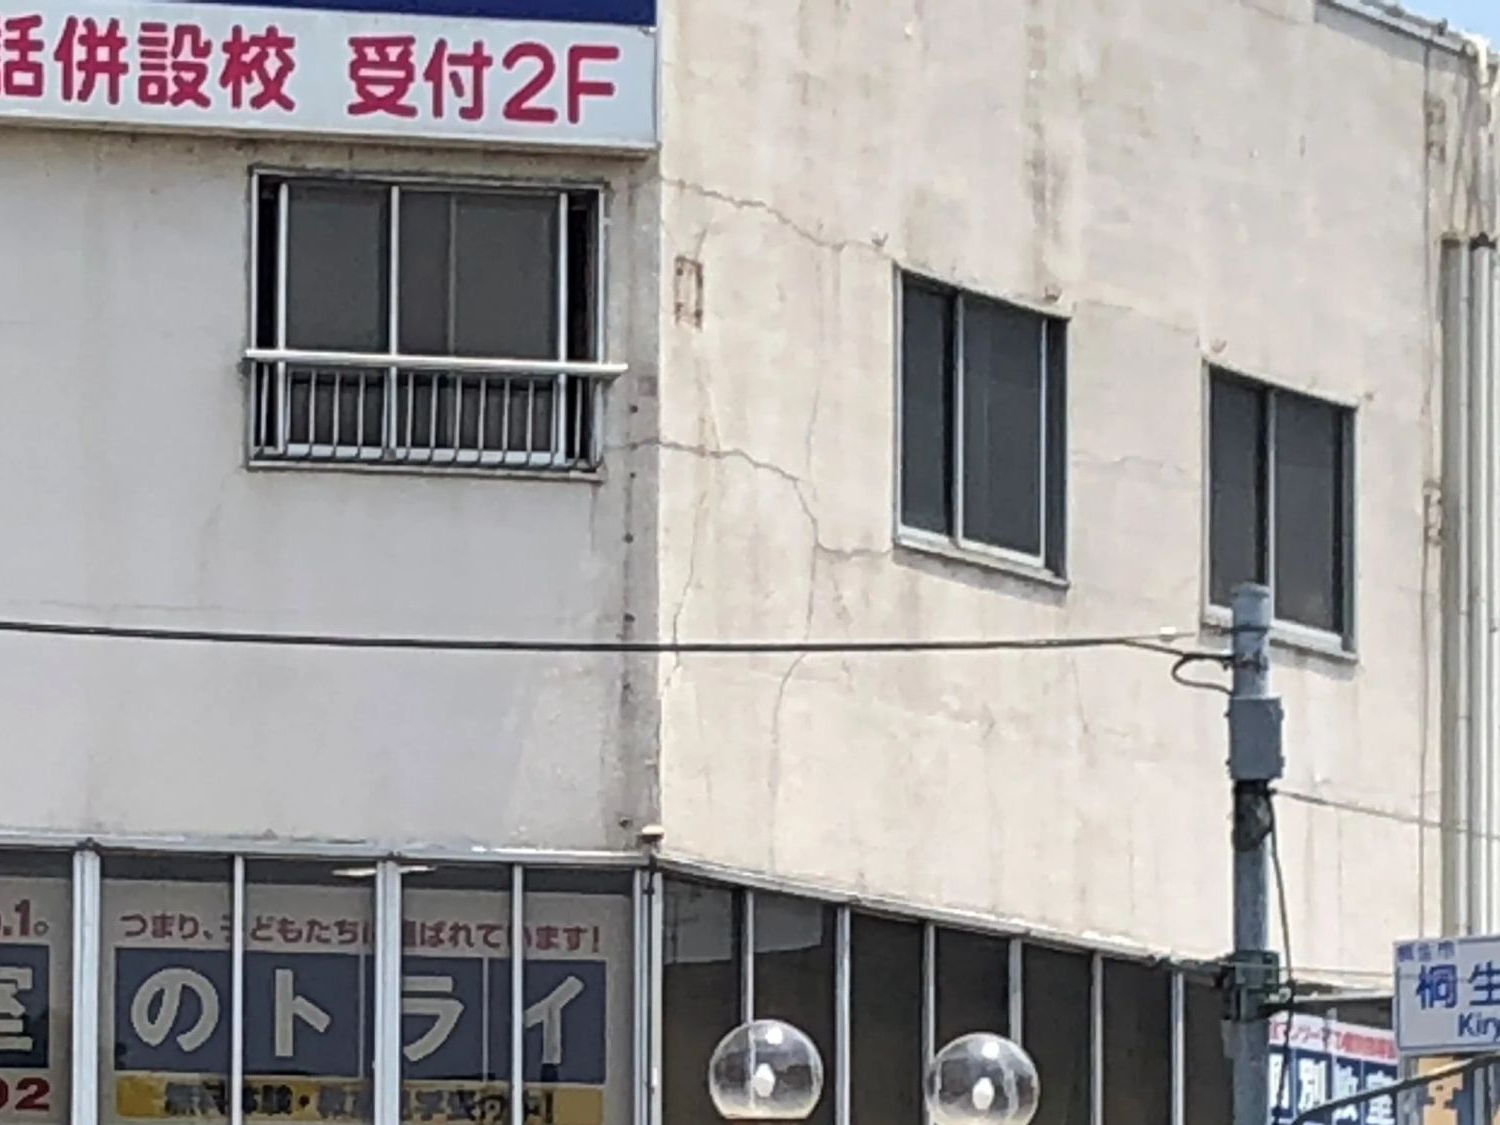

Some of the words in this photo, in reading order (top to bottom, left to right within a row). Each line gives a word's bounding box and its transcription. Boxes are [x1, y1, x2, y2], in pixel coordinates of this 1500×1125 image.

[346, 35, 622, 124] 受付2F
[129, 967, 585, 1065] のトライ
